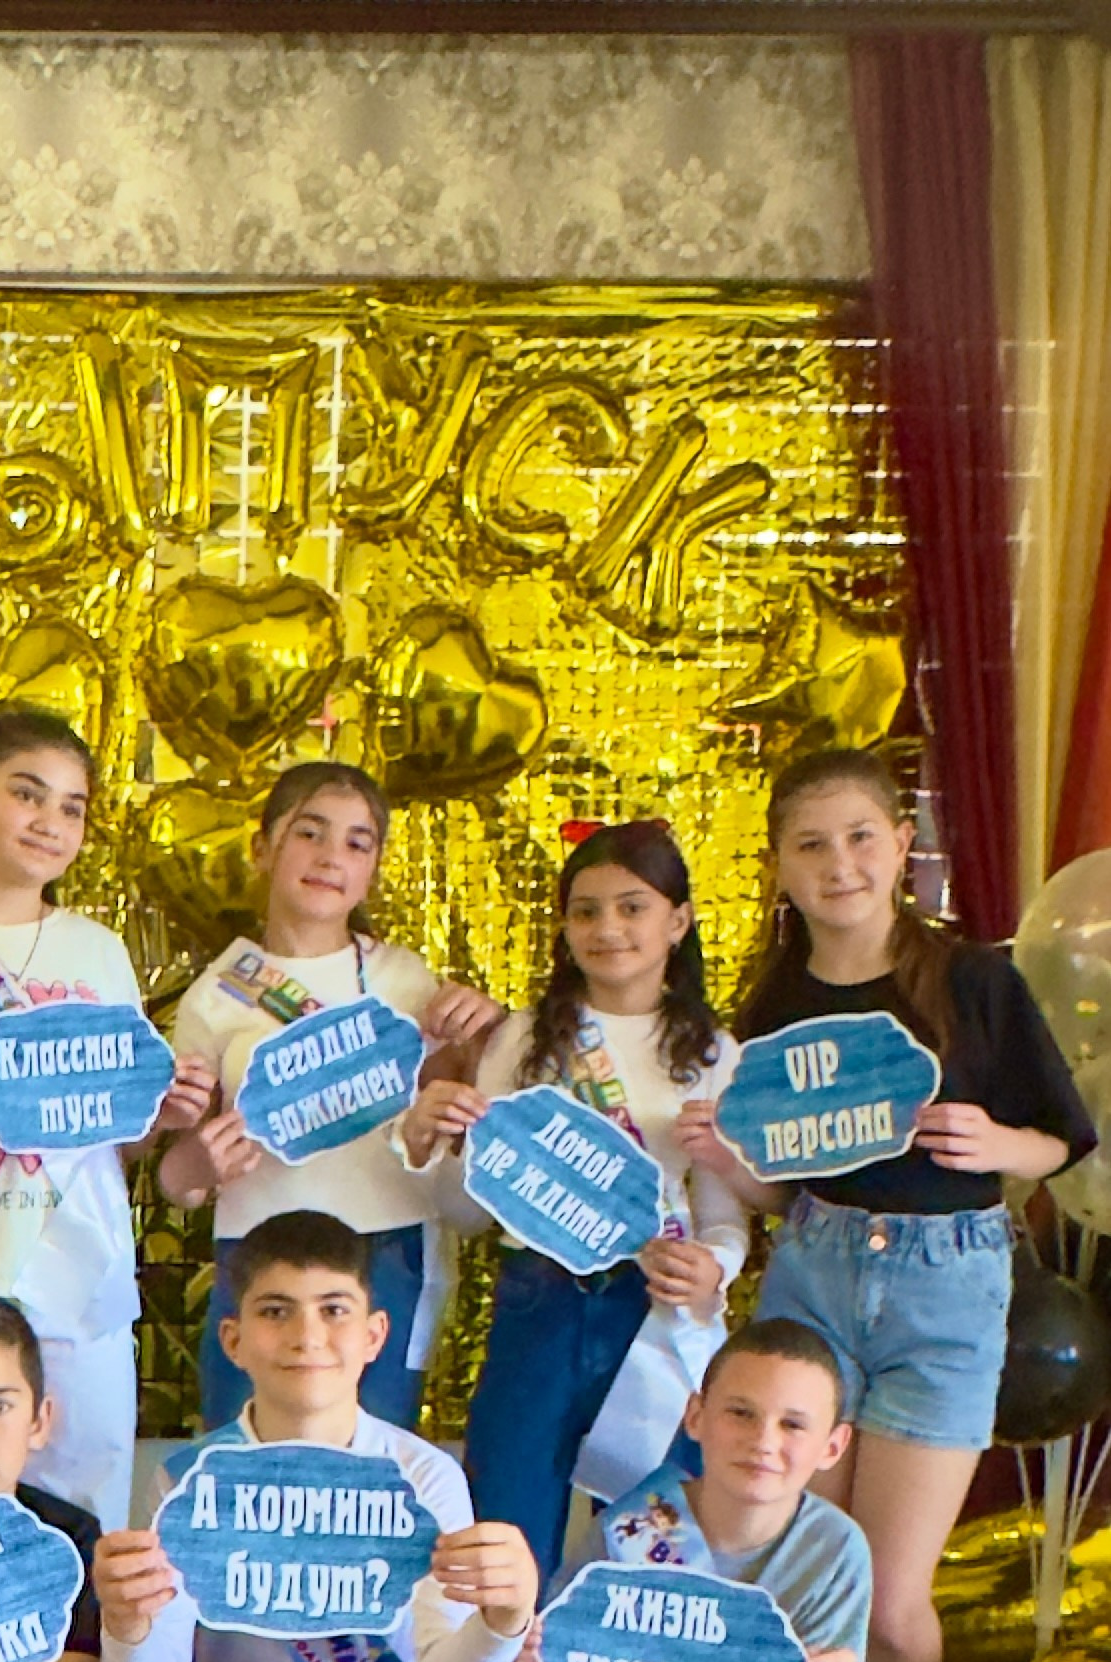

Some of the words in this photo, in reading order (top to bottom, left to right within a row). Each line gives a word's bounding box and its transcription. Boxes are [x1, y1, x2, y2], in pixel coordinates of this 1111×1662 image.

[264, 1010, 377, 1087] сегодня
[784, 1039, 840, 1093] VIP
[38, 1091, 114, 1135] туса
[268, 1058, 406, 1147] зажигаем
[763, 1100, 893, 1163] персона
[530, 1111, 627, 1192] Домой
[476, 1137, 519, 1179] не
[509, 1162, 628, 1257] ждите!
[191, 1473, 219, 1530] А
[233, 1484, 416, 1538] кормить
[226, 1550, 391, 1618] будут?
